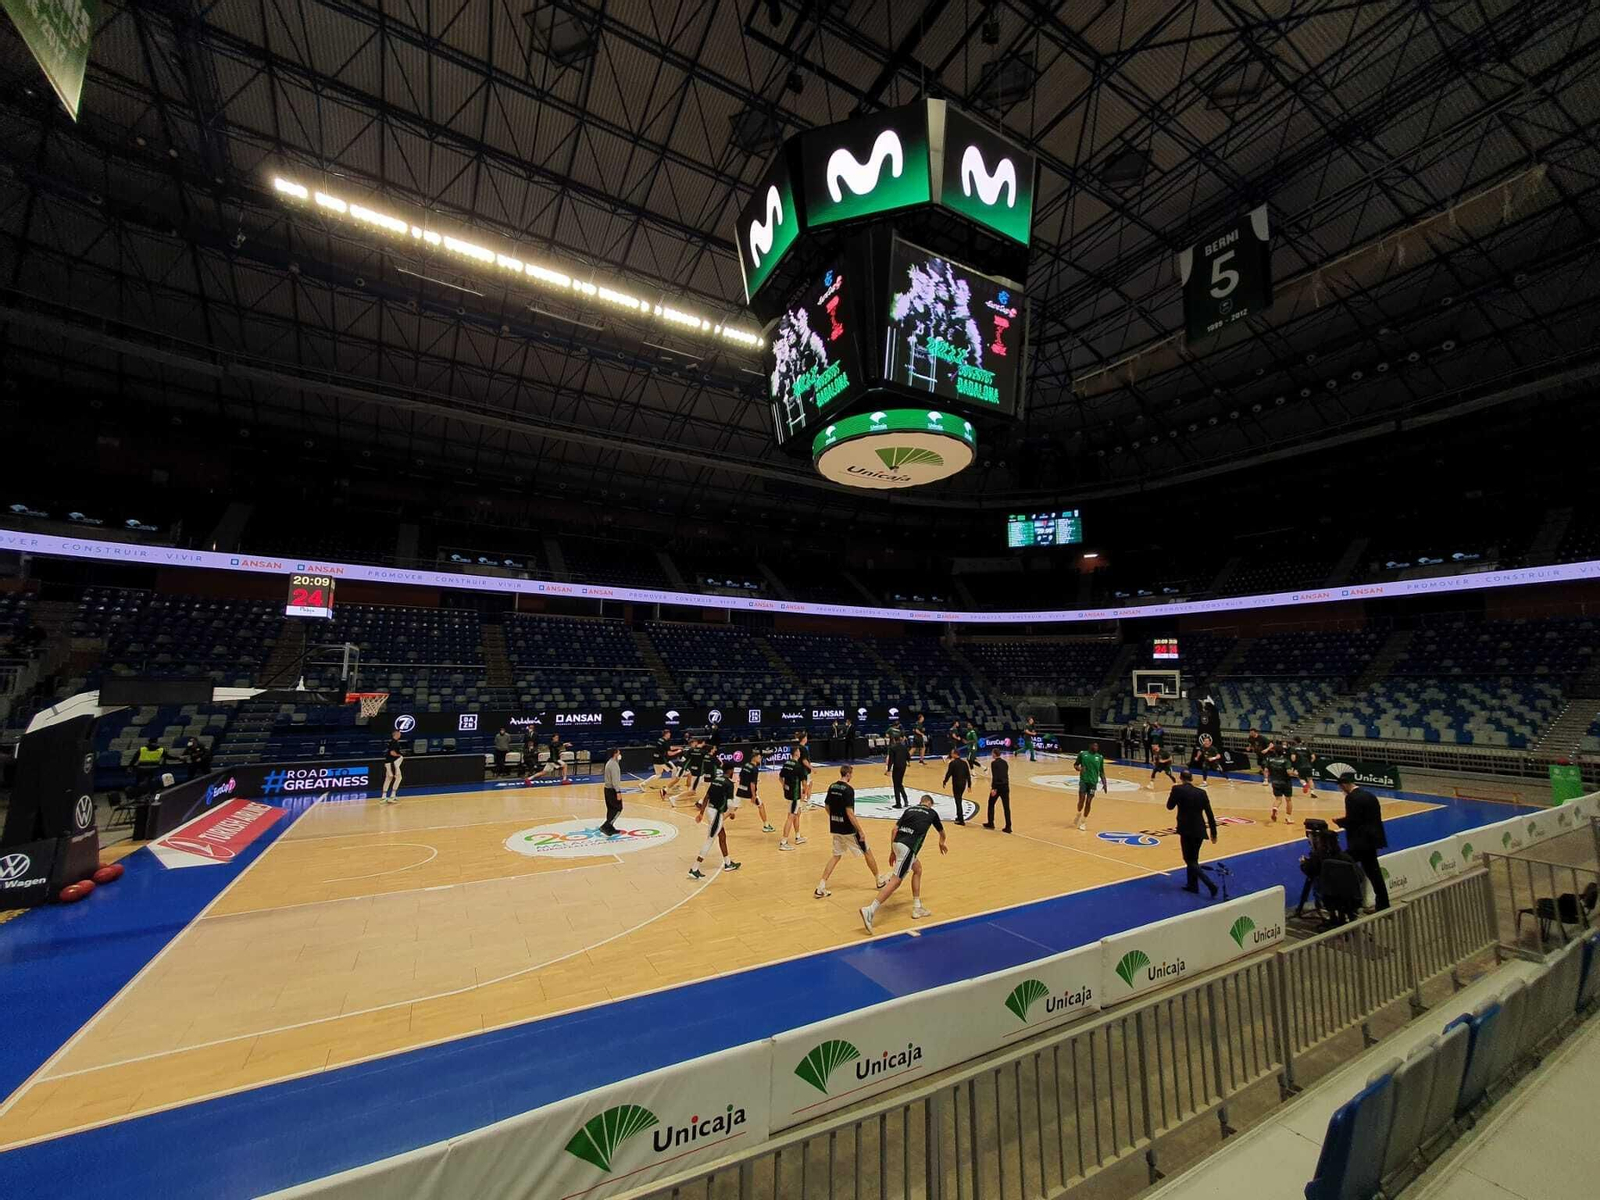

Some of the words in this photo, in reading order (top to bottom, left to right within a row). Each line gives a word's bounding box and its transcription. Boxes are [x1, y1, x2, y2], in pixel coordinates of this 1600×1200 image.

[1204, 229, 1239, 257] BERNI
[1210, 249, 1240, 298] 5
[847, 465, 911, 483] Unicaja
[62, 543, 148, 557] CONSTRUIR
[166, 552, 203, 563] VIVIR
[241, 559, 282, 569] ANSAN
[307, 565, 344, 575] ANSAN
[293, 576, 330, 587] 20:09
[368, 570, 423, 581] PROMOVER
[435, 576, 487, 586] CONSTRUIR
[1406, 578, 1469, 591] PROMOVER
[1485, 569, 1561, 583] CONSTRUIR
[545, 585, 573, 593] ANSAN
[588, 588, 614, 597] ANSAN
[1300, 592, 1330, 600] ANSAN
[1350, 586, 1384, 596] ANSAN
[292, 588, 323, 607] 24
[565, 713, 602, 723] ANSAN
[819, 710, 845, 718] ANSAN
[331, 768, 350, 777] TO
[1354, 773, 1394, 785] Unicaja
[283, 776, 369, 791] GREATNESS
[198, 817, 251, 843] TURKISH
[4, 877, 47, 889] Wagen
[1389, 876, 1408, 889] Unicaja
[1253, 923, 1281, 944] Unicaja
[1148, 957, 1186, 981] Unicaja
[1045, 985, 1093, 1014] Unicaja
[855, 1042, 923, 1080] Unicaja
[652, 1103, 747, 1152] Unicaja
